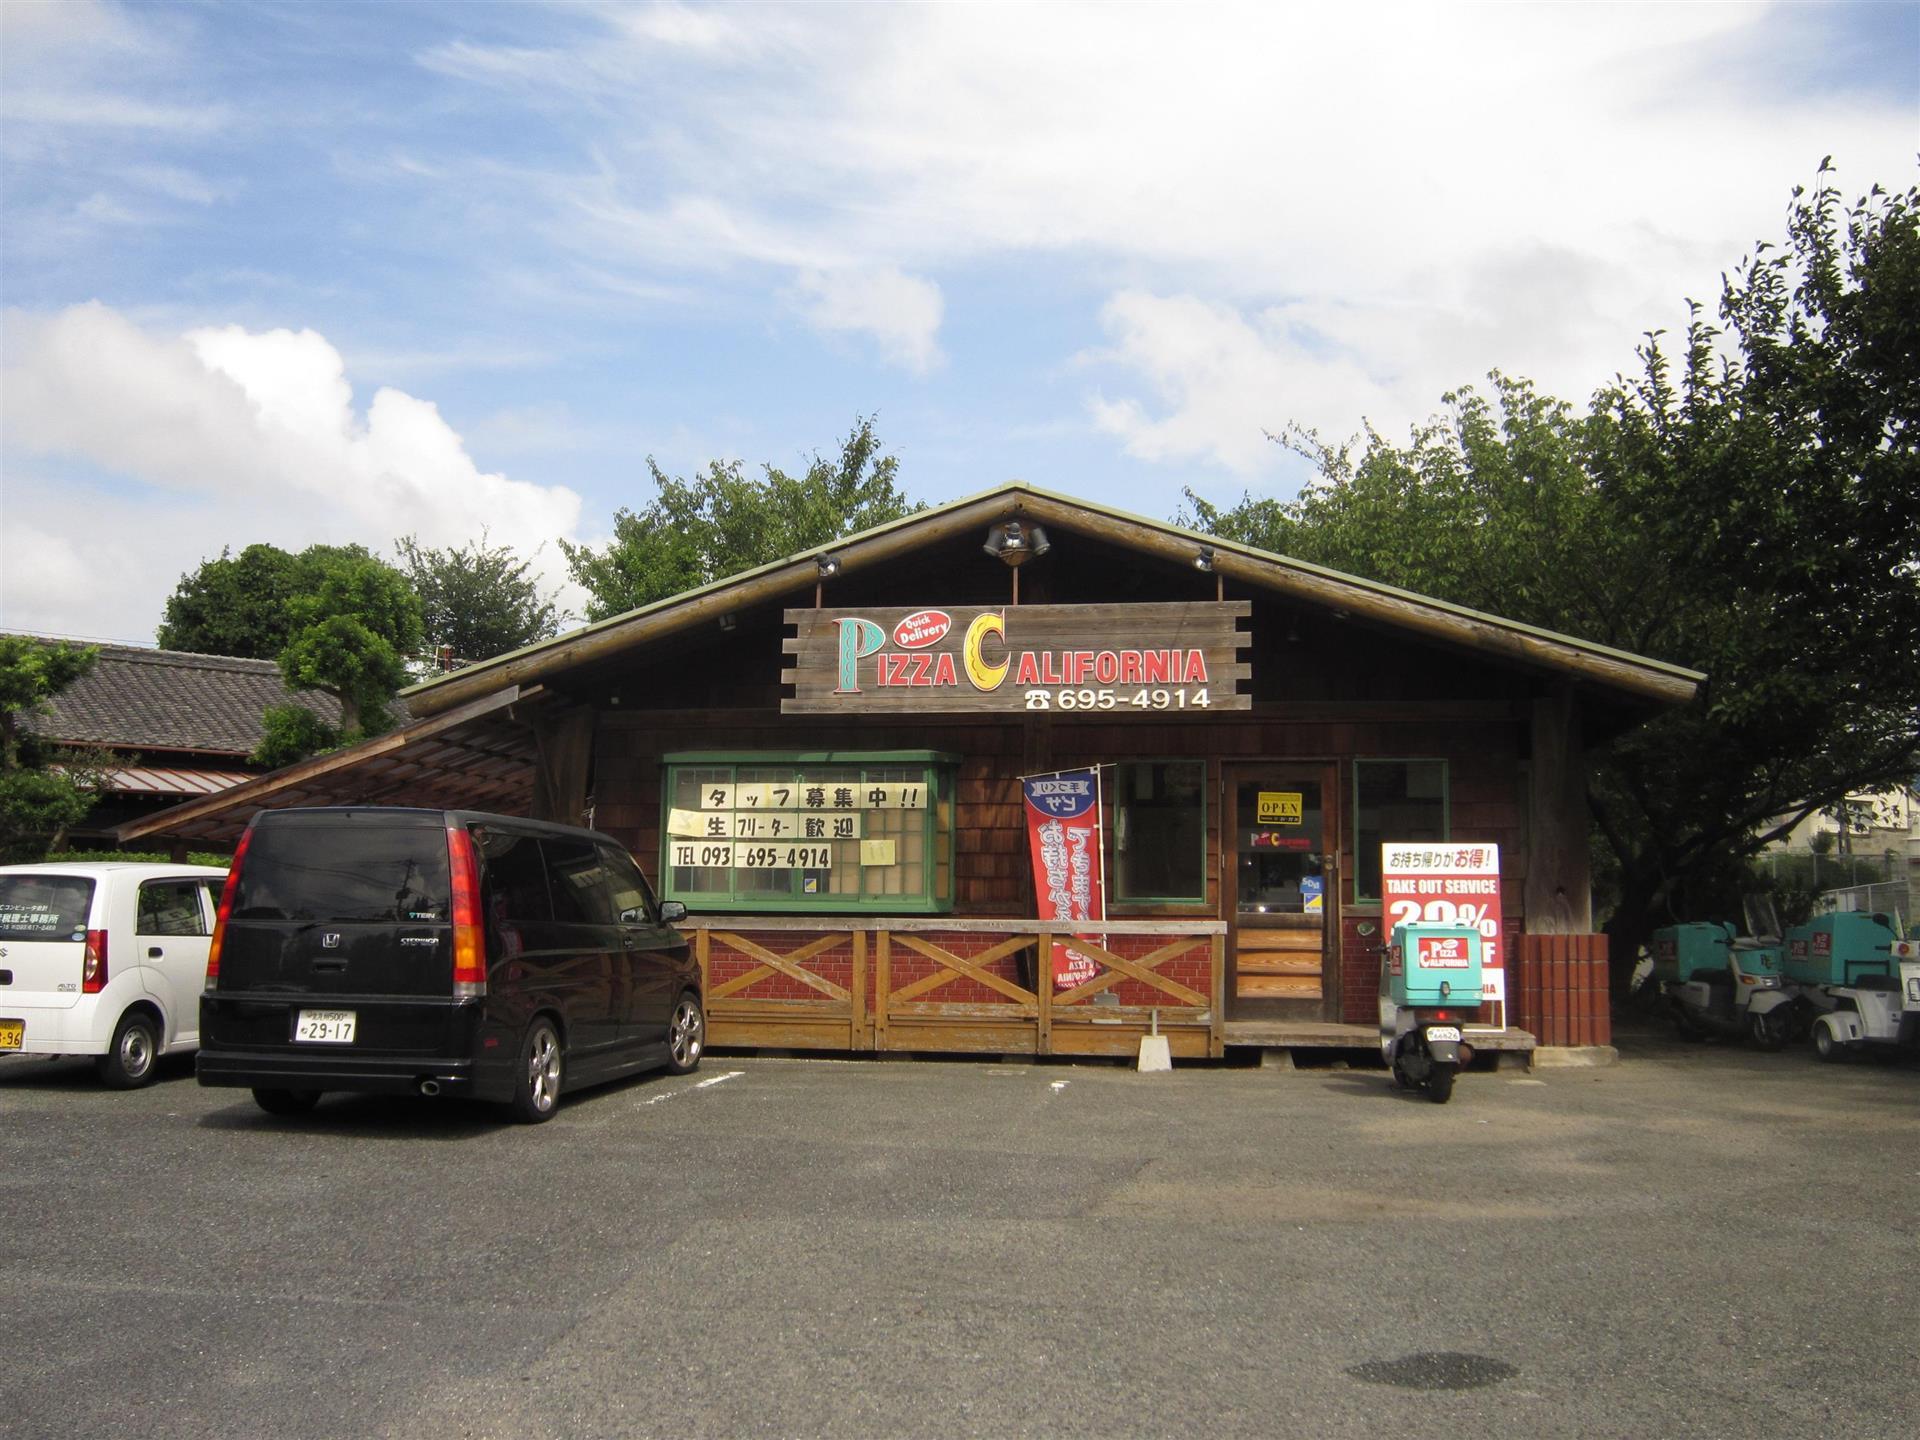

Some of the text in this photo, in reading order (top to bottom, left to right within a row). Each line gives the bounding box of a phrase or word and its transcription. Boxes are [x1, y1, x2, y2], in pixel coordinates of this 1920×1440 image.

[905, 614, 931, 630] Quick
[900, 622, 948, 645] Delivery
[832, 607, 1209, 694] PIZZA CALIFORNIA
[1057, 688, 1211, 710] 695-4914
[677, 846, 695, 865] TEL
[1386, 879, 1497, 895] TAKE OUT SERVICE
[1430, 941, 1458, 958] PIZZA
[0, 1031, 20, 1045] -96
[308, 1022, 352, 1039] 29-17
